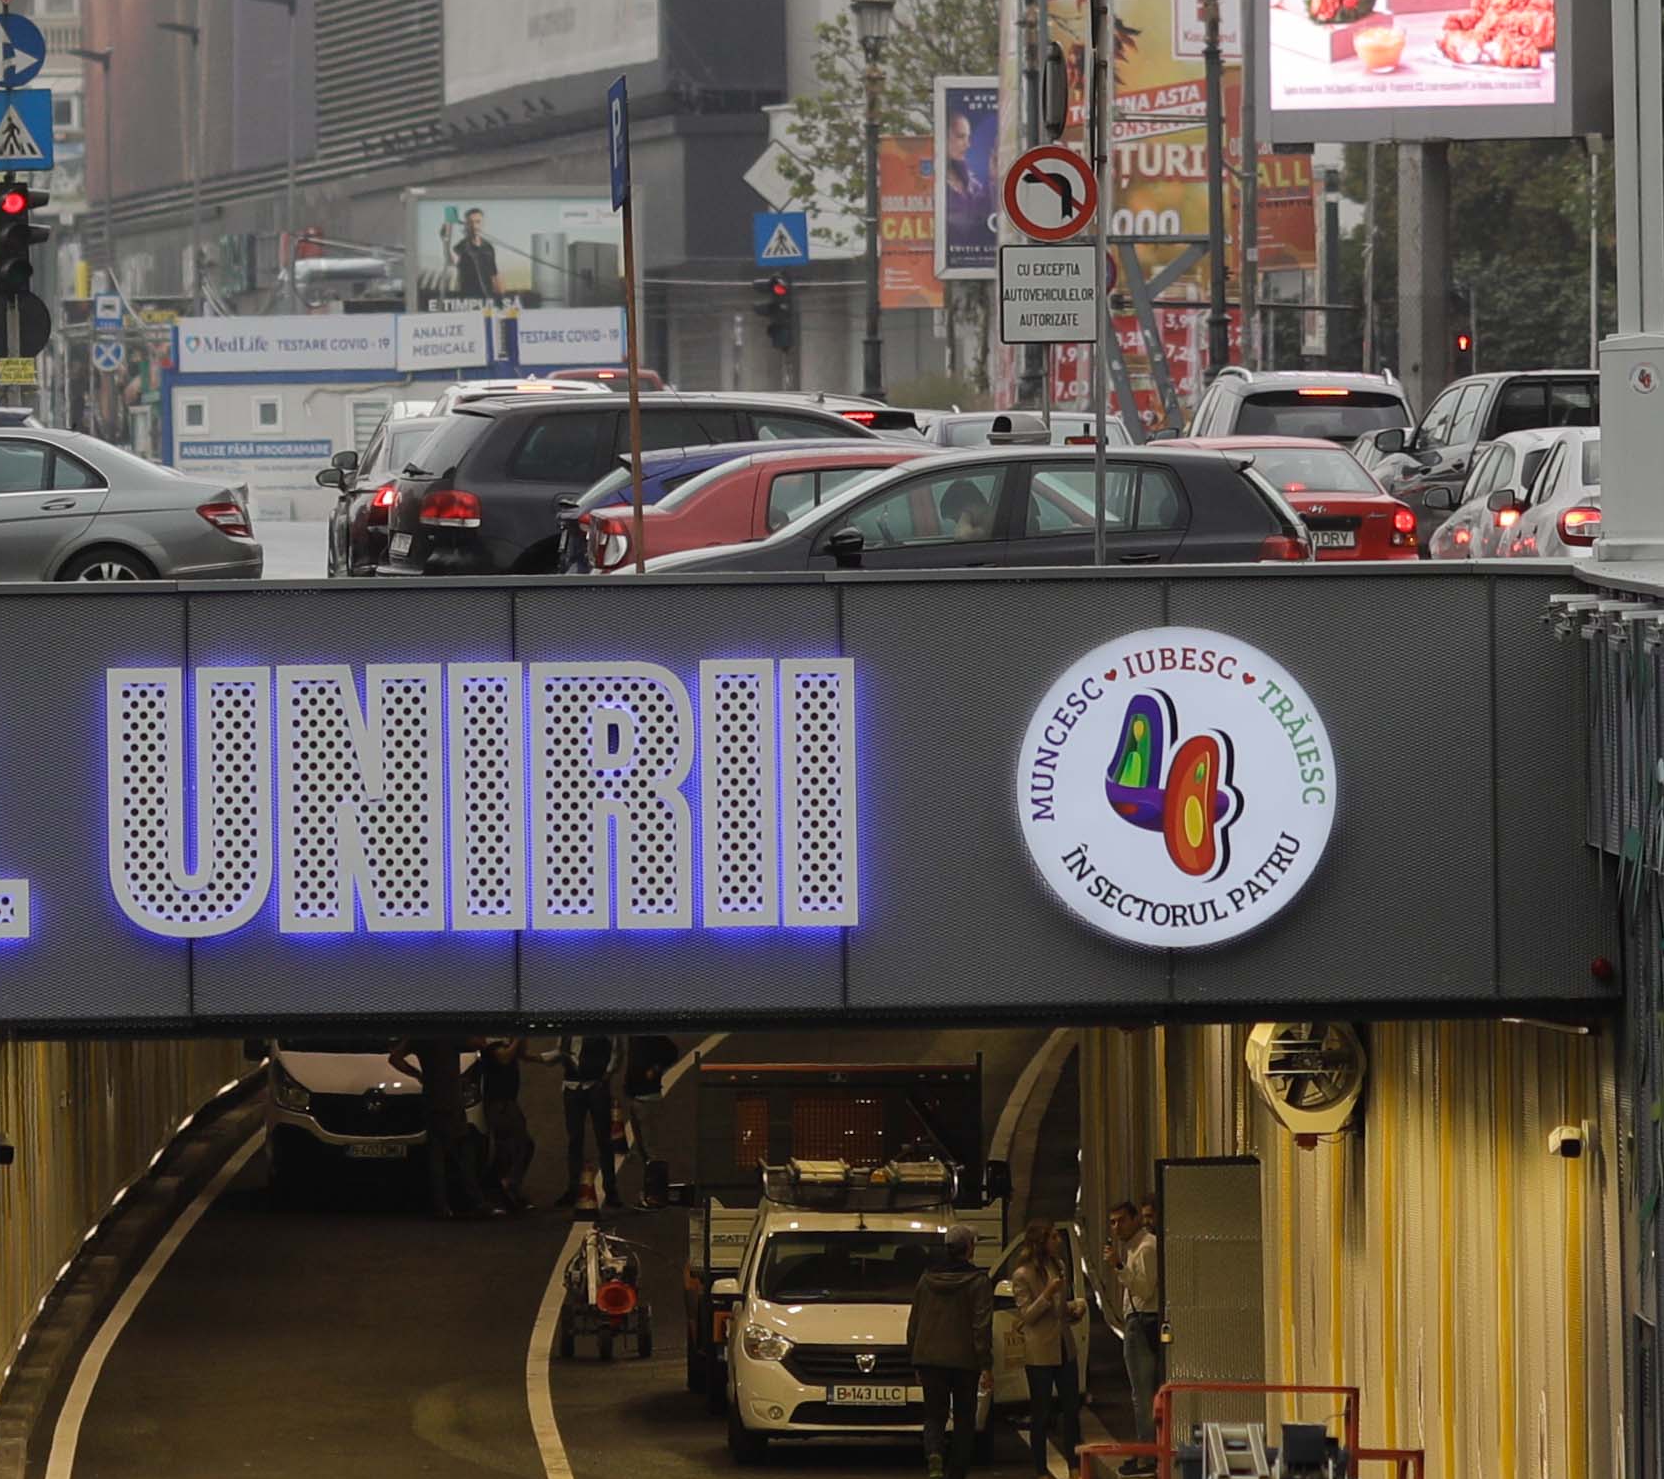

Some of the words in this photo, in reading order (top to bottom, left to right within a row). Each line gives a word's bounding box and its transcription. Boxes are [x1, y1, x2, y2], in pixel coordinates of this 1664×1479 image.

[1154, 85, 1201, 108] ASTA
[1017, 263, 1030, 276] CU
[1033, 263, 1081, 276] EXCEPTIA
[1003, 288, 1094, 302] AUTOVEHICULELOR
[428, 300, 437, 312] E
[1020, 313, 1079, 327] AUTORIZATE
[413, 324, 464, 339] ANALIZE
[520, 330, 565, 344] TESTARE
[566, 329, 602, 342] COVID
[203, 336, 269, 353] MedLife
[277, 338, 327, 352] TESTARE
[330, 337, 368, 351] COVID
[378, 337, 390, 349] 19
[413, 341, 475, 356] MEDICALE
[182, 445, 226, 457] ANALIZE
[1031, 677, 1104, 822] MUNCESC
[1123, 647, 1238, 680] IUBESC
[1257, 679, 1326, 806] TRĂIESC
[106, 657, 859, 938] UNIRII
[1061, 842, 1095, 883] ÎN
[1087, 875, 1229, 928] SECTORUL
[1227, 830, 1301, 913] PATRU
[837, 1388, 845, 1400] B
[851, 1388, 871, 1400] 143
[876, 1388, 901, 1400] LLC
